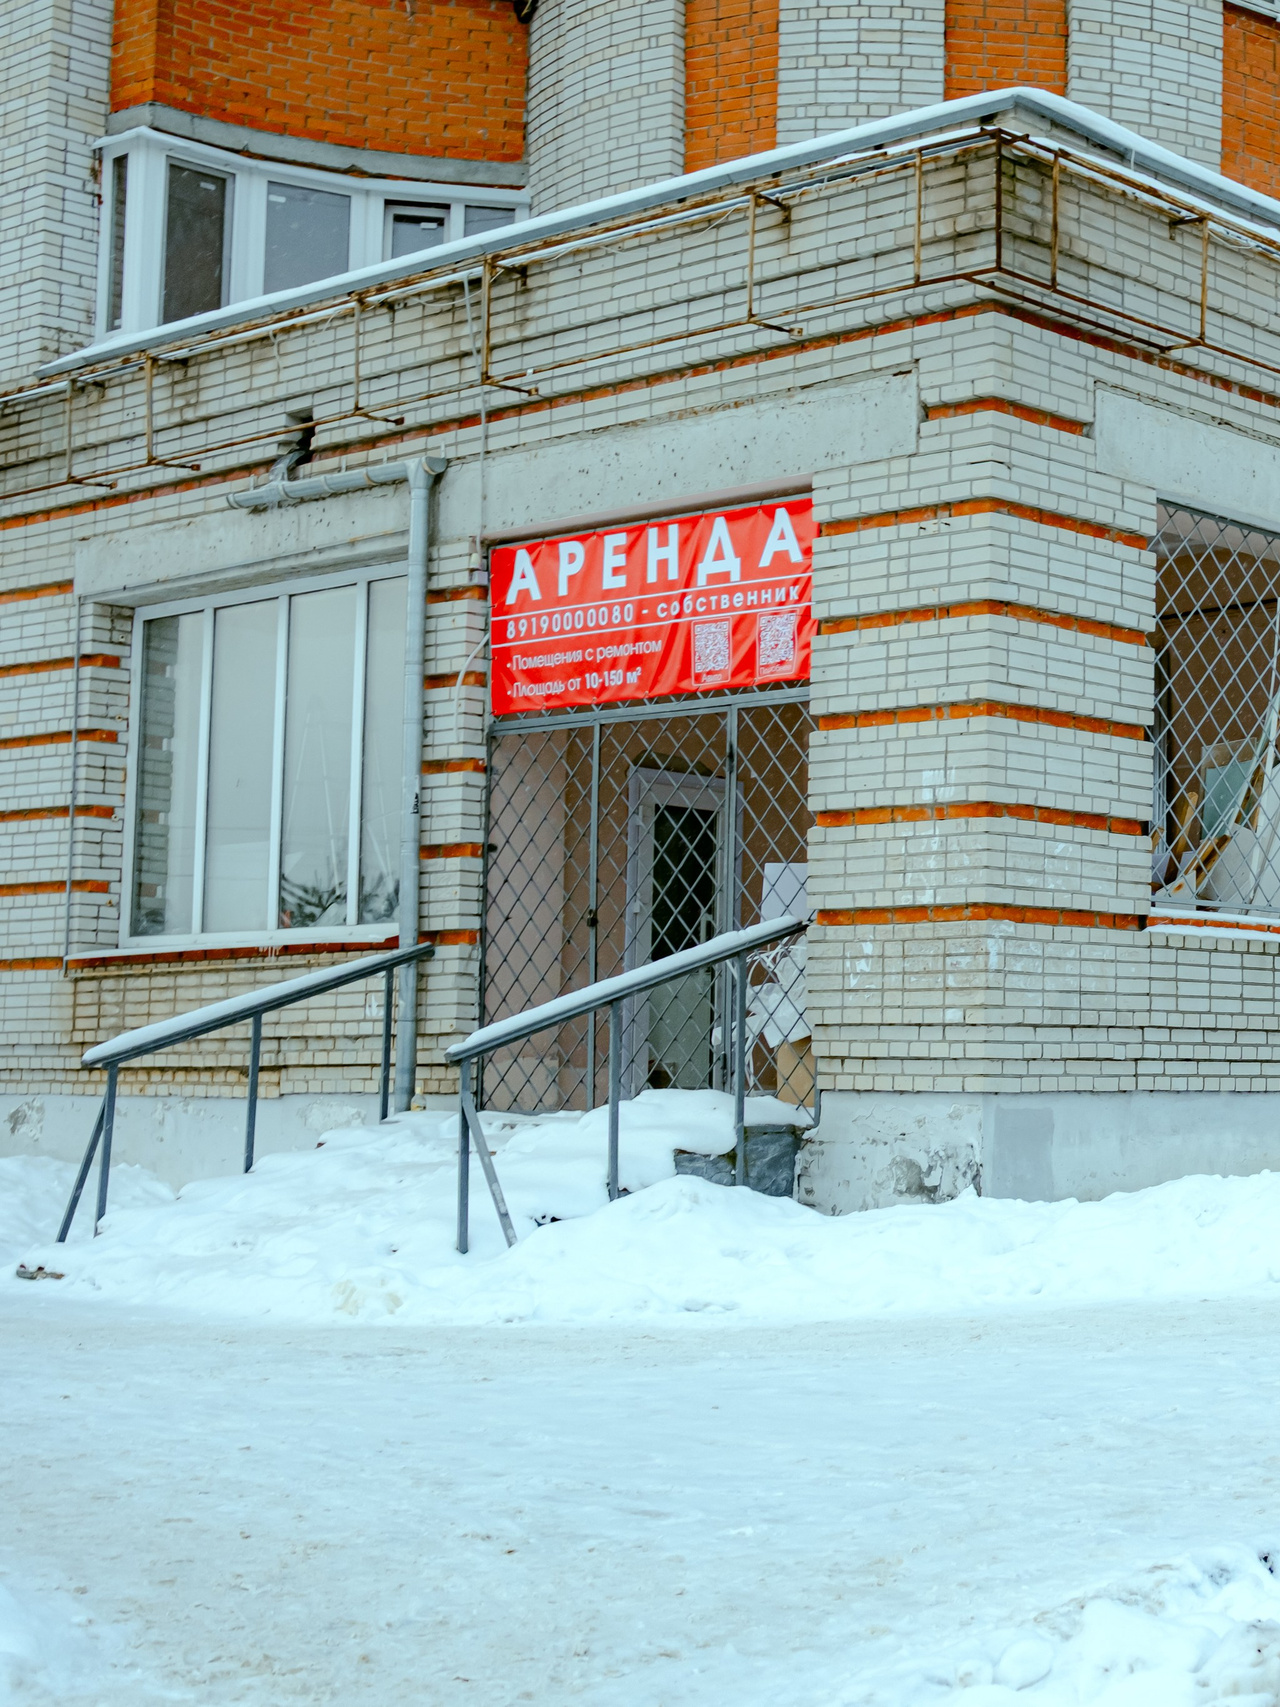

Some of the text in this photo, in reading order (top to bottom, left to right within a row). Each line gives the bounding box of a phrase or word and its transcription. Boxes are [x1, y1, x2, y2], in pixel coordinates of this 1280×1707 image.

[505, 507, 803, 605] АРЕНДА
[506, 603, 633, 639] 89190000080
[656, 585, 799, 618] собственник
[512, 639, 662, 670] Помещения с ремонтом
[512, 680, 565, 697] Площадь
[567, 677, 581, 691] от
[585, 669, 623, 689] 10-150
